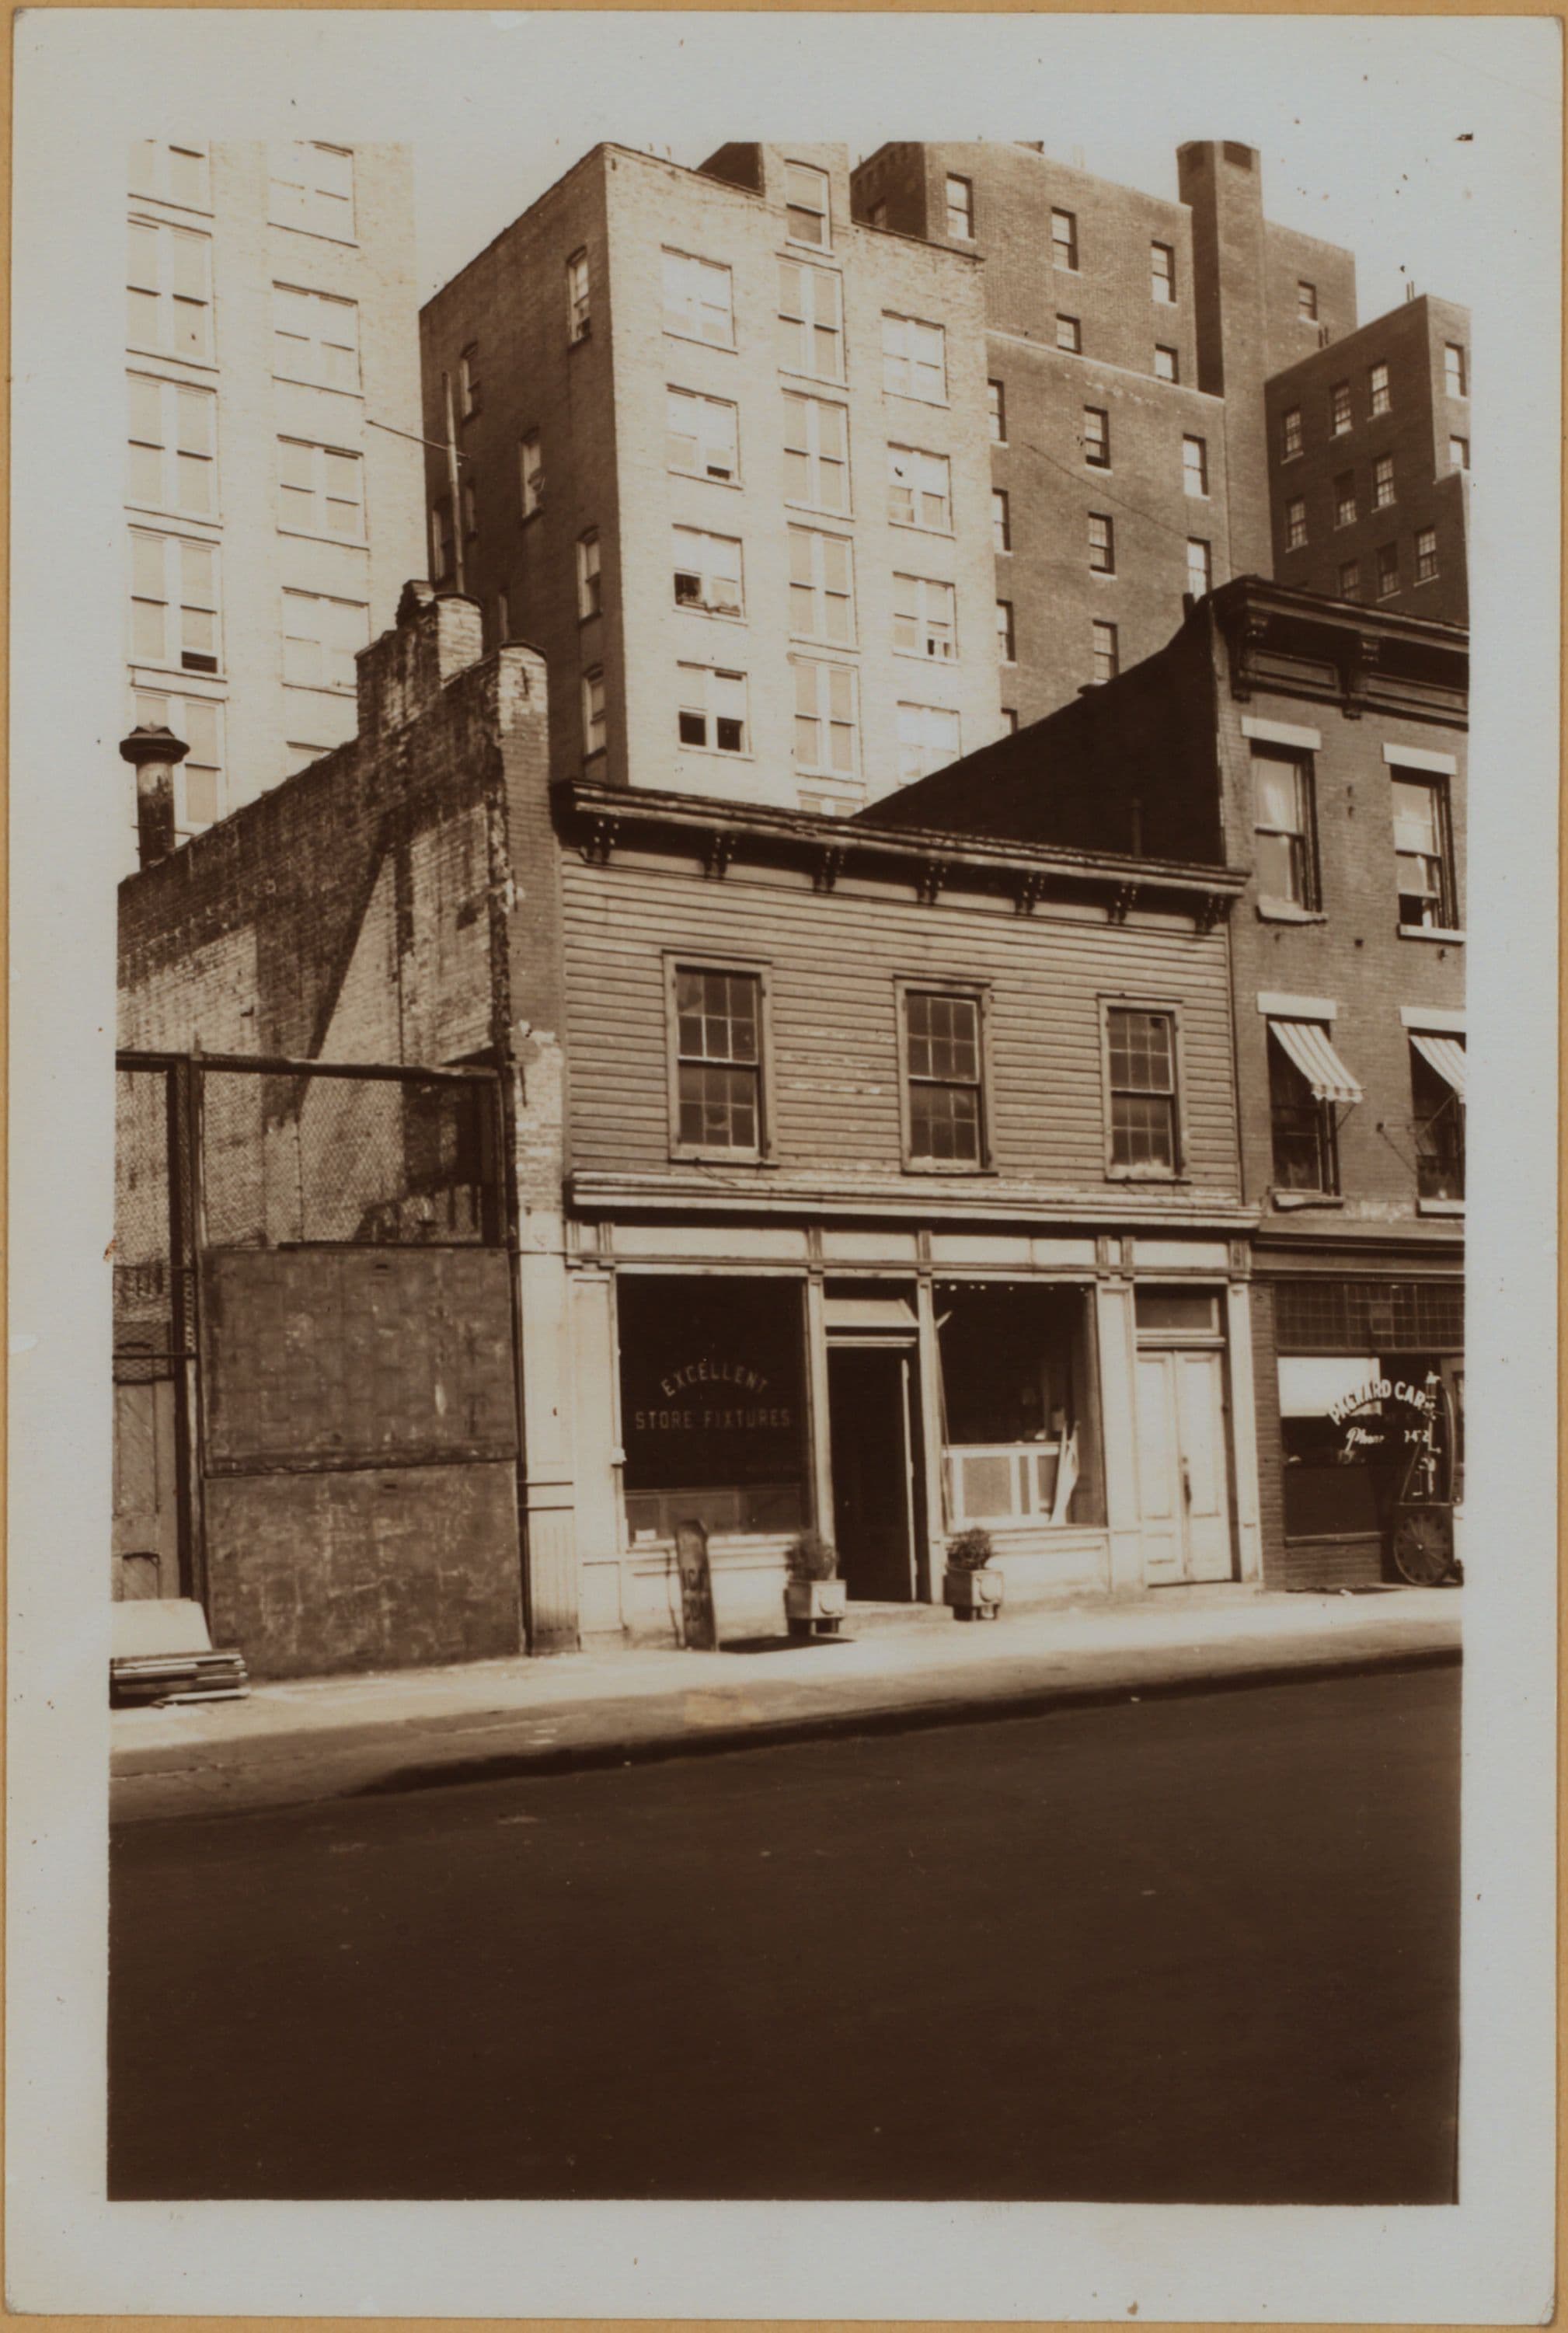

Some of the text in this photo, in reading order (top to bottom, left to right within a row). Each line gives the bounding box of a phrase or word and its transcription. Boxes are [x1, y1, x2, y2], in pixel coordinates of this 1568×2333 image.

[660, 1362, 768, 1397] EXCELLENT
[635, 1407, 791, 1430] STORE FIXTURES
[1328, 1378, 1392, 1425] PACKARD
